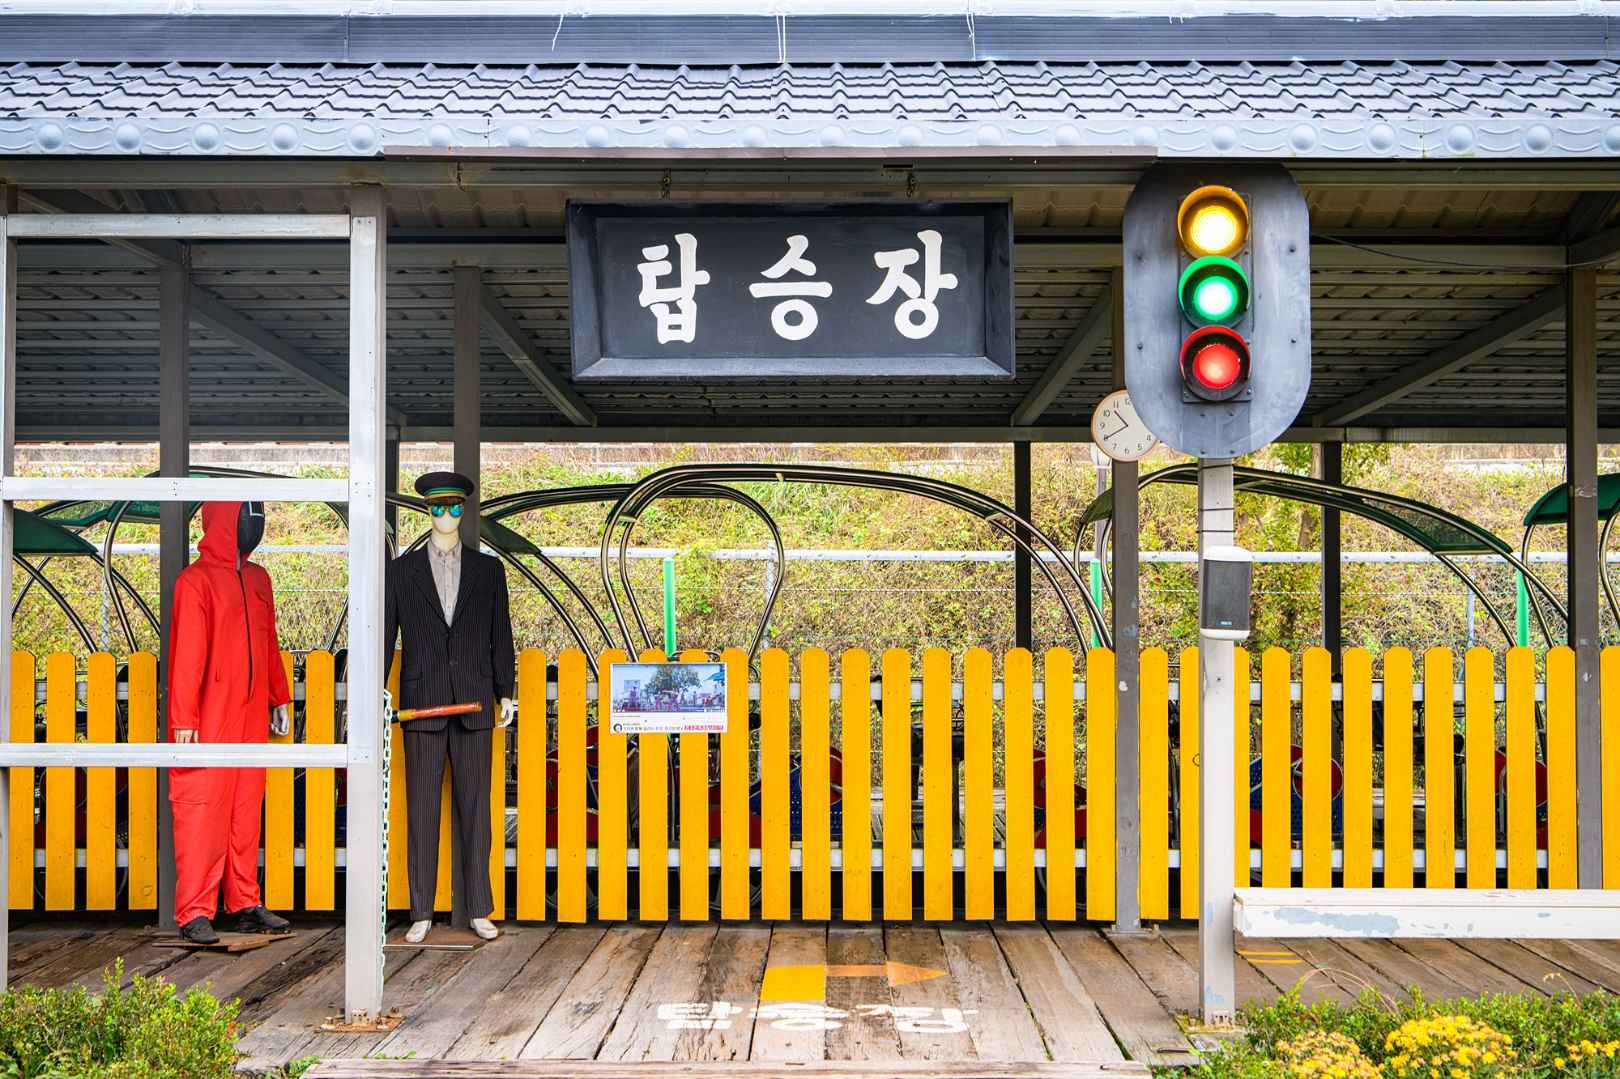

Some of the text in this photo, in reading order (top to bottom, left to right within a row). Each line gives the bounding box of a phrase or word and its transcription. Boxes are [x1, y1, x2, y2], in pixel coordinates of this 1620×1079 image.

[637, 229, 959, 344] 탑승장
[1113, 400, 1119, 408] 11
[1103, 409, 1110, 417] 10
